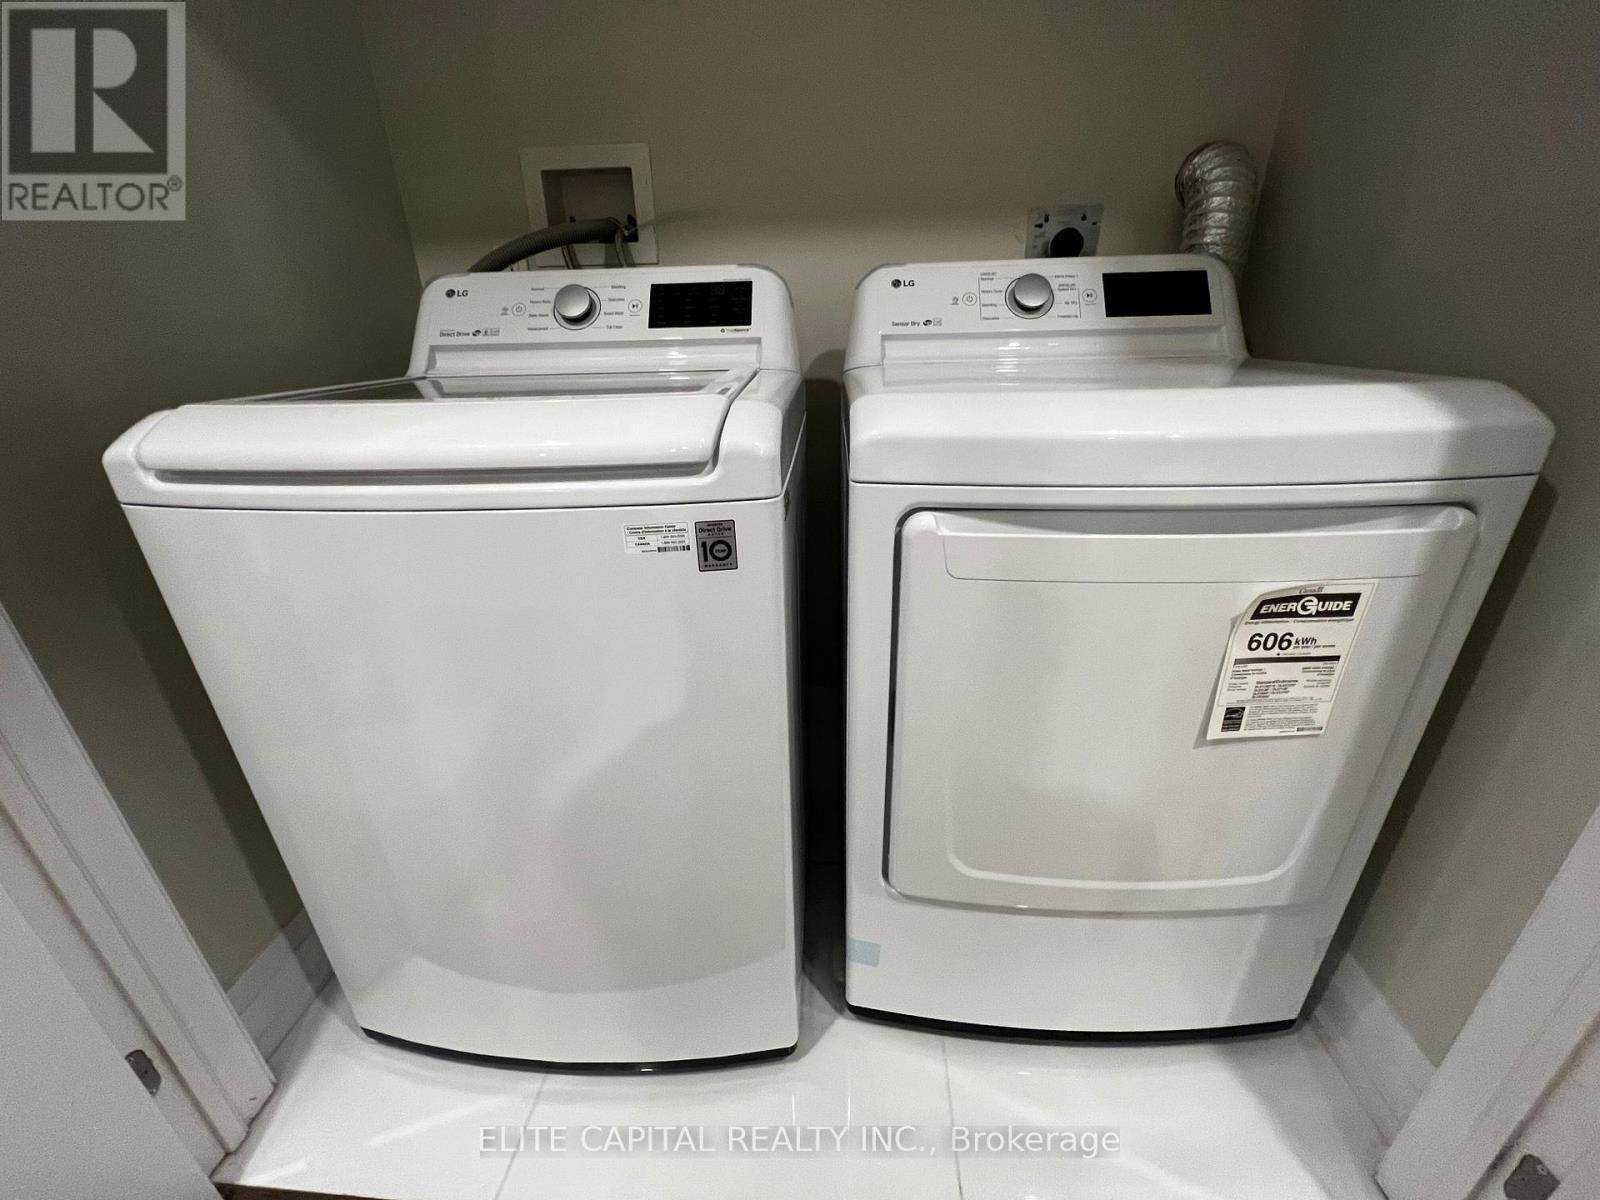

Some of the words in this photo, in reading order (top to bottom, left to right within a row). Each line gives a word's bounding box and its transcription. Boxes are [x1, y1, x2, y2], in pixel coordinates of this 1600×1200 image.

[701, 540, 733, 563] 10
[1247, 632, 1295, 652] 606
[1295, 636, 1318, 646] kWh
